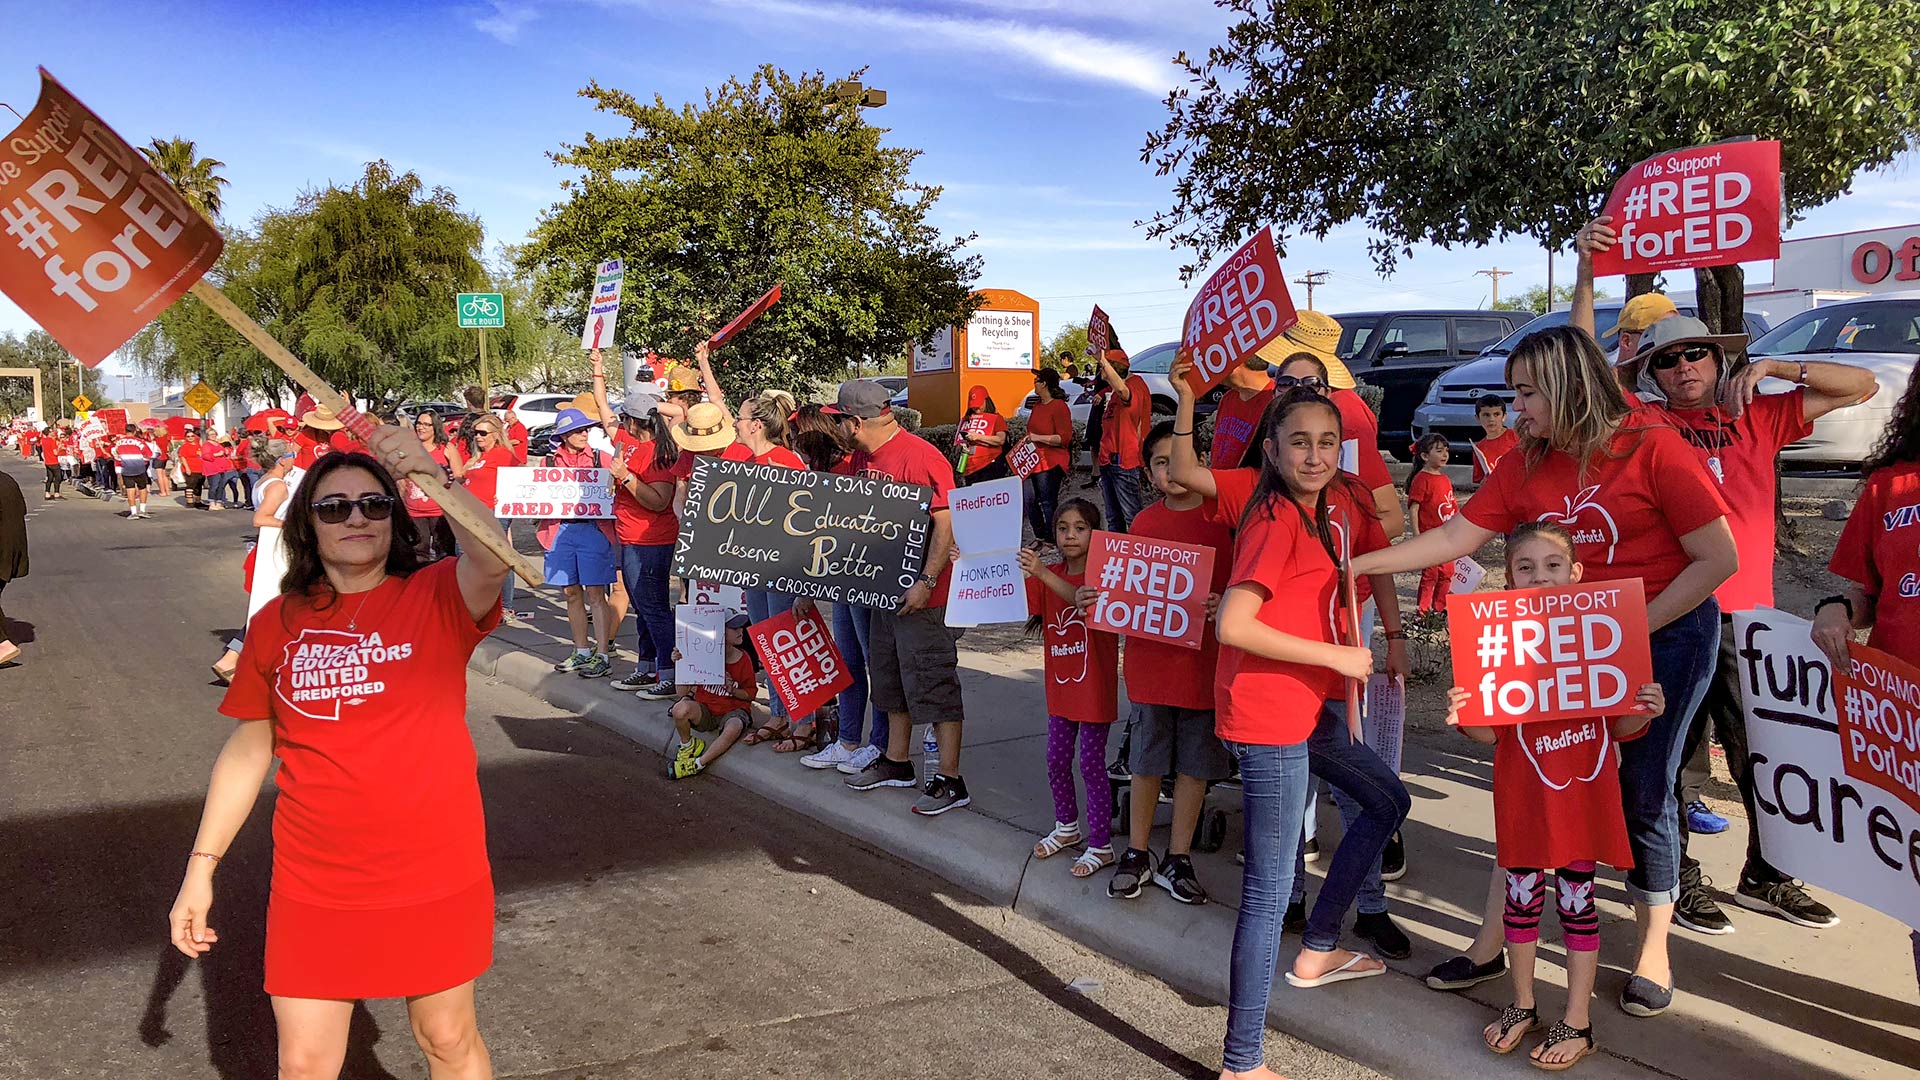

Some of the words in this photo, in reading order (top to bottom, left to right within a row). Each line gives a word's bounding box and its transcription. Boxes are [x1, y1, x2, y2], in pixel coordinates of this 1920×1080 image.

[10, 98, 72, 165] Support
[1643, 162, 1662, 178] We
[1666, 152, 1721, 176] Support
[1, 119, 132, 259] #RED
[1623, 172, 1751, 220] #RED
[44, 172, 189, 312] forED
[1618, 213, 1752, 260] forED
[1205, 241, 1259, 298] SUPPORT
[1004, 316, 1010, 325] &
[1012, 316, 1031, 326] Shoe
[1187, 264, 1265, 347] #RED
[982, 327, 1019, 339] Recycling
[1193, 299, 1278, 383] forED
[532, 469, 599, 482] HONK!
[720, 460, 817, 488] CUSTODIANS
[1018, 453, 1040, 480] forED
[517, 485, 536, 498] IF
[548, 485, 613, 499] YOU'R
[684, 456, 710, 519] NURSES
[834, 476, 876, 495] SVCS
[881, 483, 921, 501] FOOD
[955, 492, 1010, 511] #RedForED
[501, 502, 553, 516] #RED
[561, 503, 602, 516] FOR
[707, 481, 773, 525] All
[783, 490, 902, 541] Educators
[1883, 503, 1920, 531] VI
[1105, 538, 1130, 554] WE
[1133, 543, 1200, 566] SUPPORT
[1572, 528, 1605, 544] edForEd
[718, 528, 780, 563] deserve
[803, 535, 883, 580] Better
[898, 519, 927, 588] OFFICE
[1456, 560, 1471, 574] FOR
[688, 563, 760, 587] MONITORS
[776, 577, 842, 600] CROSSING
[847, 590, 899, 610] GAURDS
[960, 567, 990, 582] HONK
[991, 563, 1010, 578] FOR
[1100, 556, 1194, 601] #RED
[958, 583, 1015, 600] #RedForED
[1470, 600, 1509, 619] WE
[1515, 589, 1620, 617] SUPPORT
[1094, 591, 1189, 638] forED
[756, 633, 783, 676] Apoyamos
[795, 618, 840, 686] forED
[1051, 641, 1084, 657] #RedForEd
[1476, 614, 1622, 668] #RED
[291, 643, 412, 672] EDUCATORS
[772, 629, 819, 695] #RED
[291, 666, 368, 688] UNITED
[292, 681, 385, 701] #REDFORED
[1479, 664, 1628, 717] forED
[778, 676, 799, 711] Nosotros
[1845, 685, 1920, 752] #ROJ
[1535, 722, 1597, 754] #RedForEd
